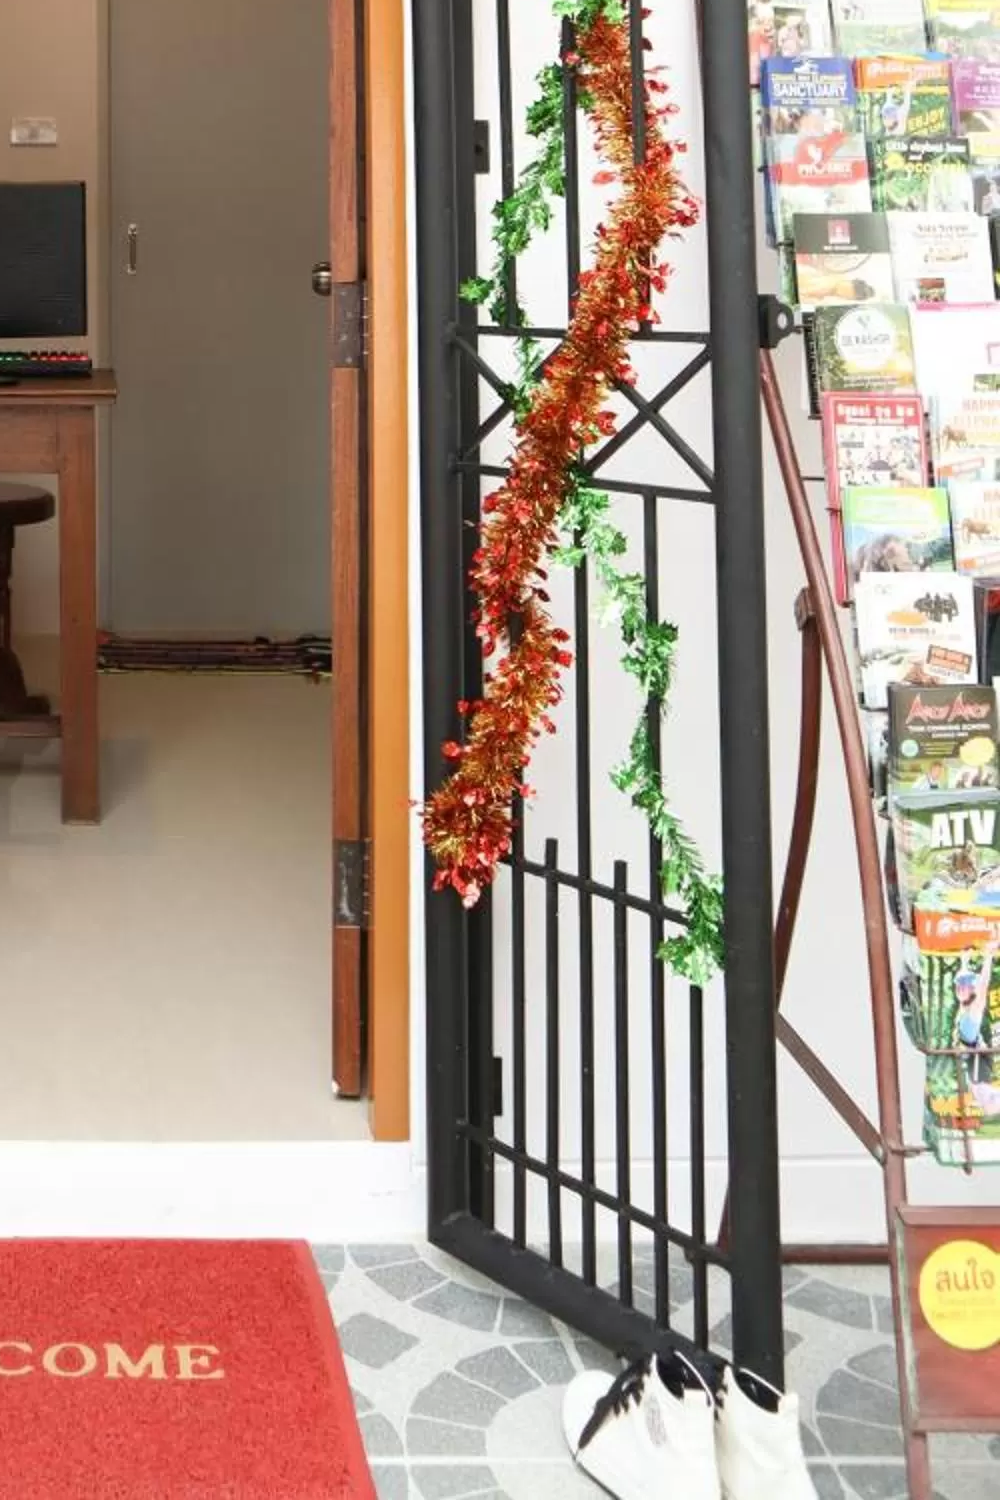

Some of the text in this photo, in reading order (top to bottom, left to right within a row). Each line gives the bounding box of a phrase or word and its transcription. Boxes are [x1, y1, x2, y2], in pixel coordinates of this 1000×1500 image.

[773, 81, 848, 98] SANCTUARY
[931, 809, 996, 848] ATV
[935, 1256, 997, 1293] สนใจ
